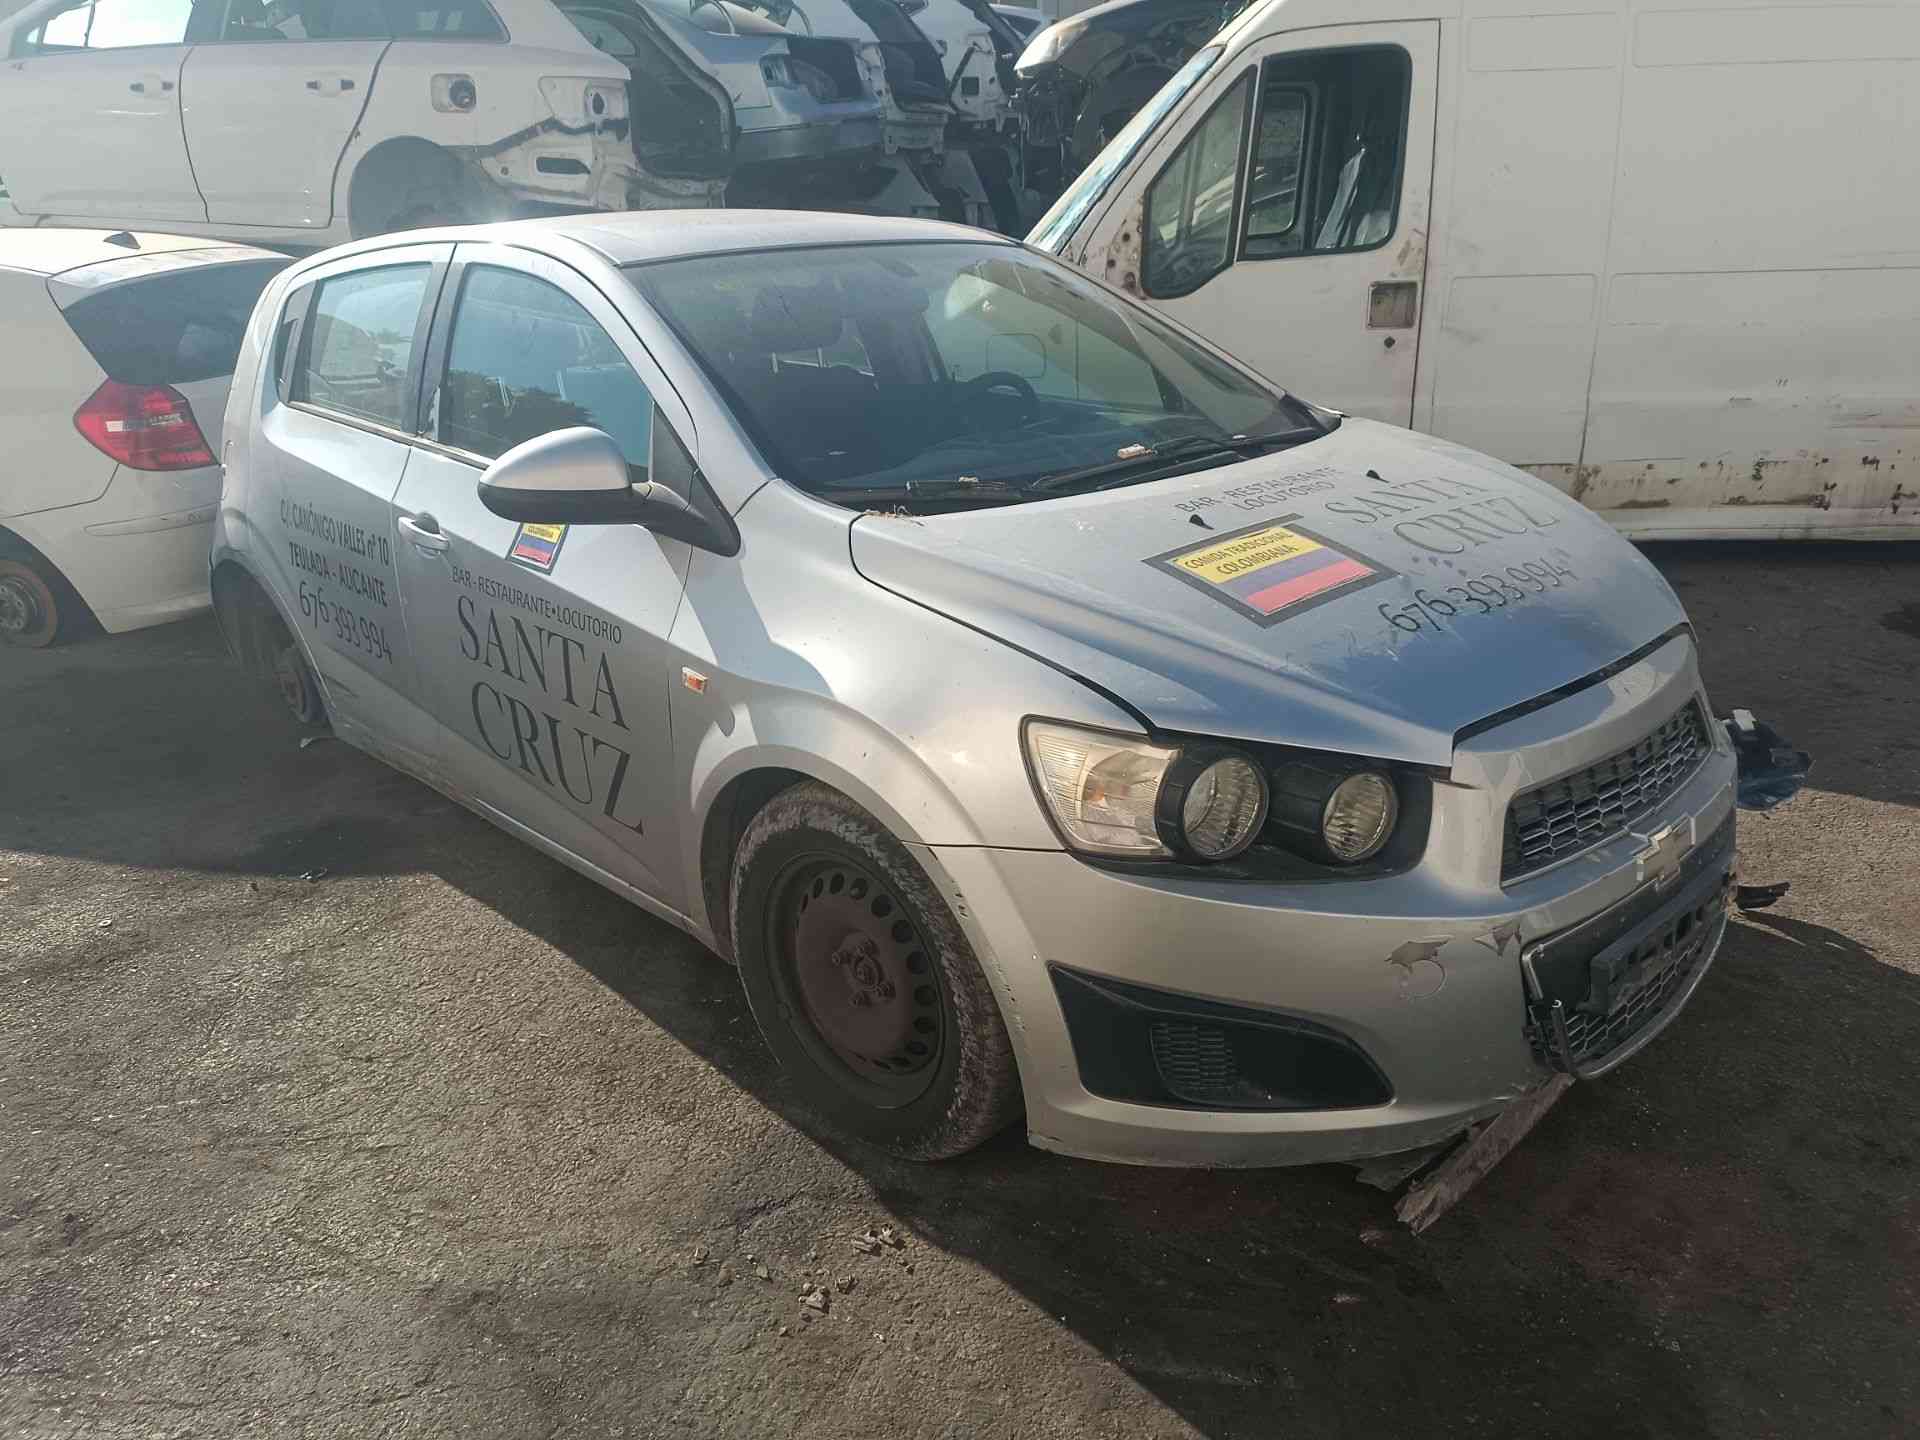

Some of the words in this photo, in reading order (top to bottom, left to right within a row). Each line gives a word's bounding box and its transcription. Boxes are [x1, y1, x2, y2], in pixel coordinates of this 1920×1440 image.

[1174, 495, 1217, 513] BAR
[1231, 479, 1336, 512] LOCUTORIO
[1324, 476, 1490, 524] SANTA
[292, 501, 336, 545] CANÓNIGO
[336, 519, 366, 557] VALLES
[377, 536, 389, 567] 10
[1184, 550, 1228, 570] COMIDA
[1223, 531, 1295, 559] TRADICIONAL
[1393, 497, 1561, 554] CRUZ
[288, 541, 331, 578] TEULADA
[338, 562, 388, 608] ALICANTE
[452, 565, 472, 589] BAR
[1215, 544, 1301, 576] COLOMBIANA
[299, 580, 330, 630] 676
[329, 601, 361, 648] 393
[359, 615, 393, 665] 994
[1377, 588, 1457, 633] 676
[1446, 573, 1525, 615] 393
[1504, 556, 1580, 593] 994
[457, 595, 631, 732] SANTA
[471, 681, 645, 836] CRUZ
